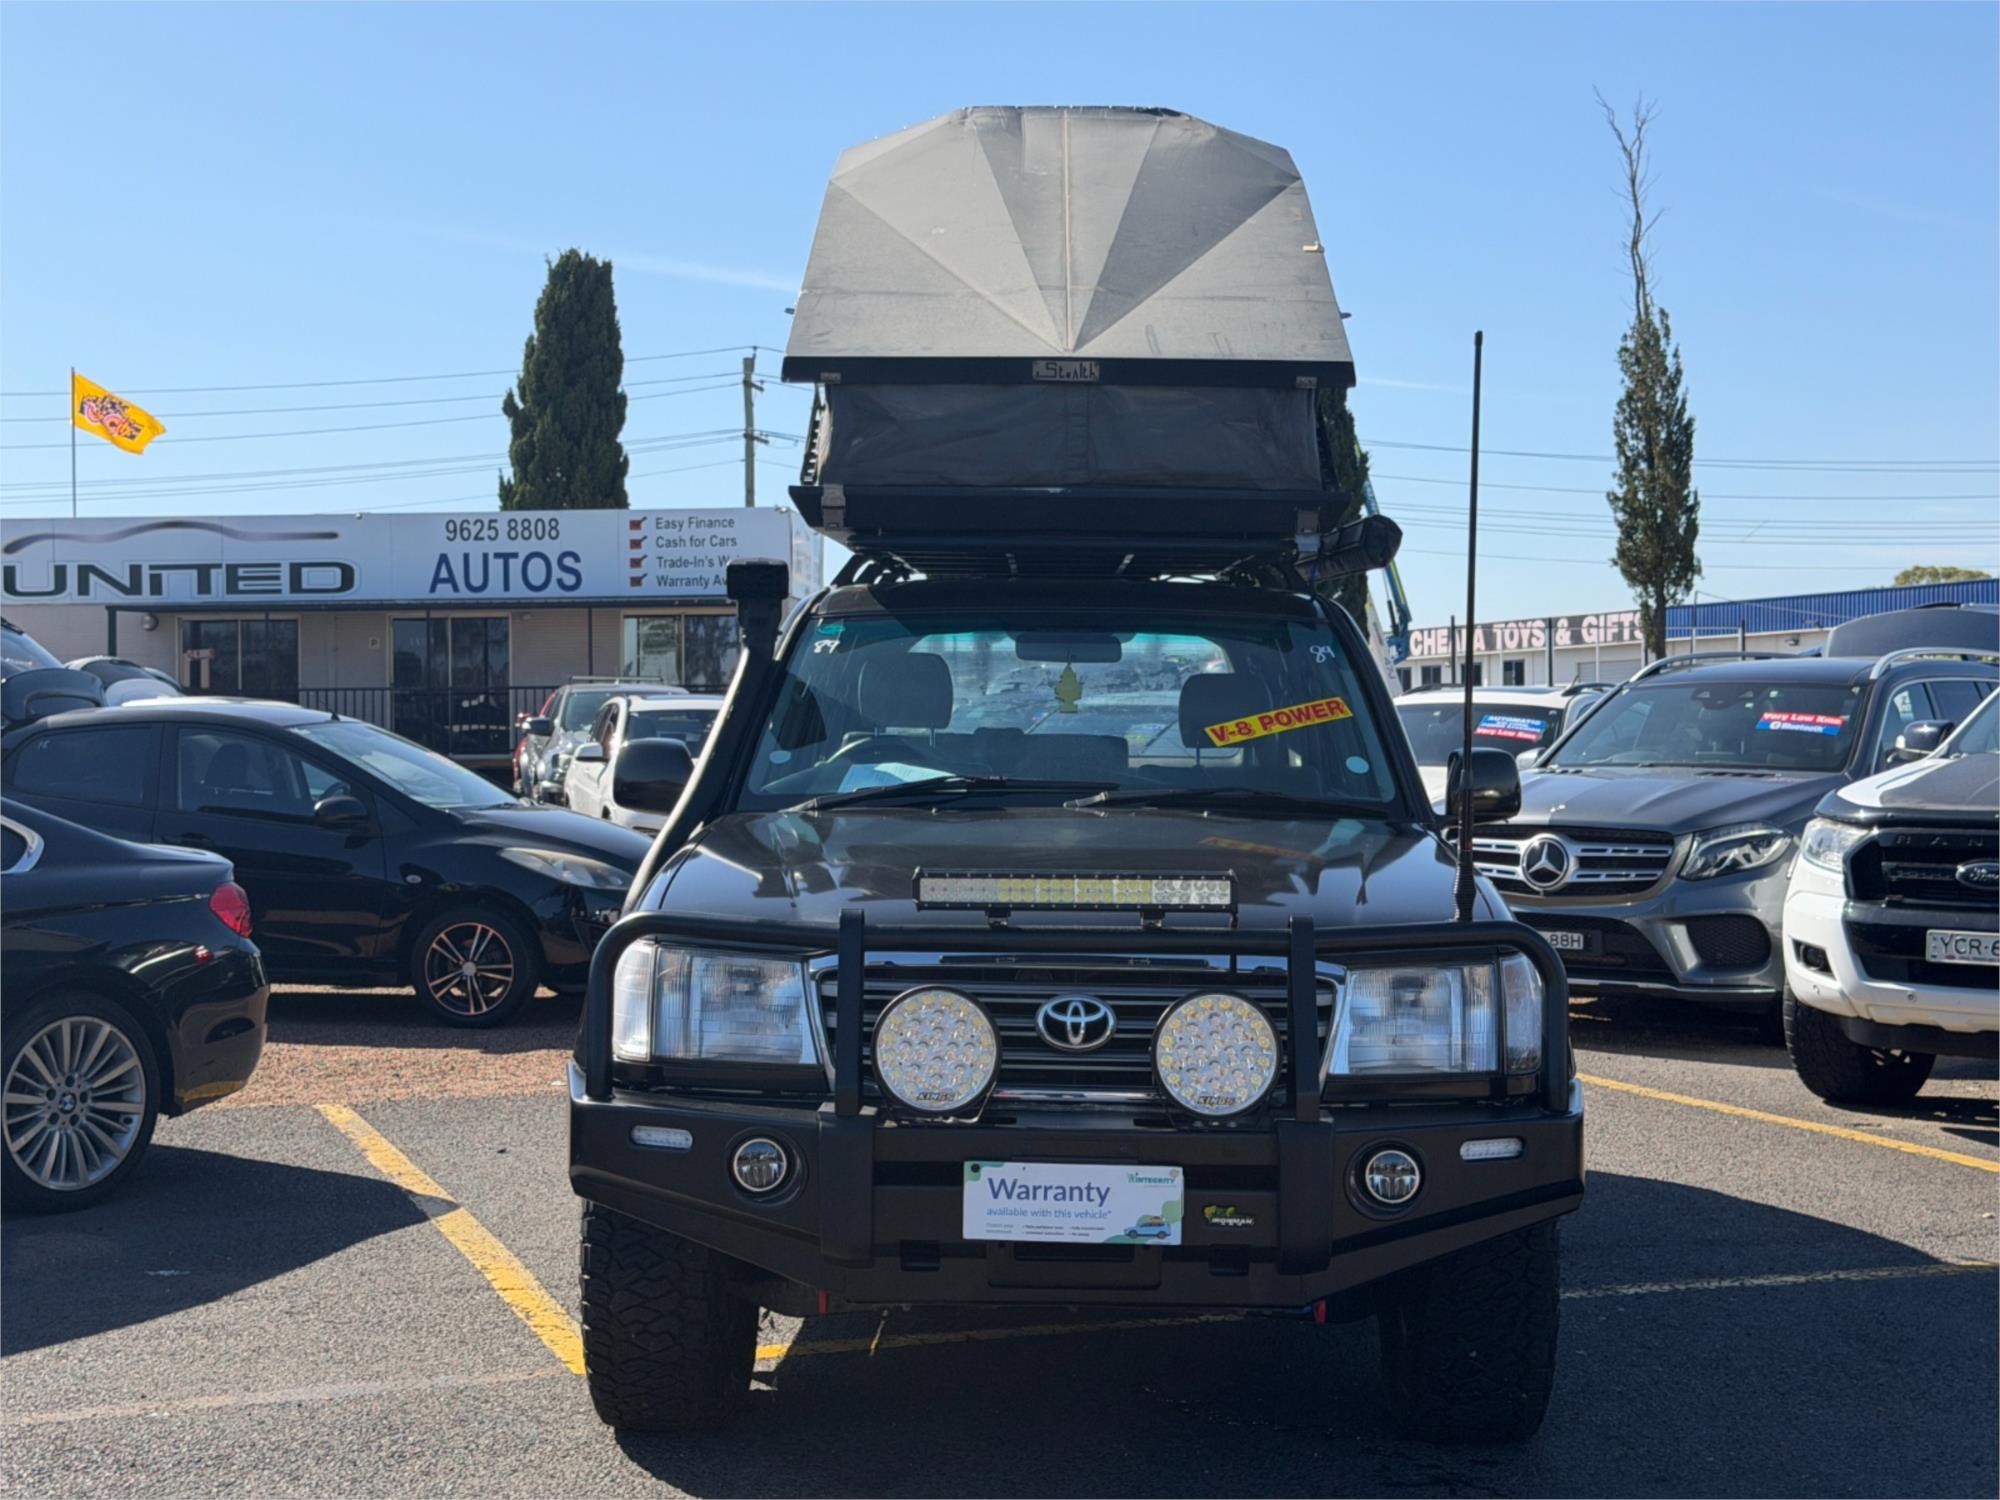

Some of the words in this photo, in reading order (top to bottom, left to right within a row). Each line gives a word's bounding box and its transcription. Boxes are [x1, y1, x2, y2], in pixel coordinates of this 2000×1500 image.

[445, 518, 499, 541] 9625
[507, 517, 560, 541] 8808
[655, 517, 684, 532] Easy
[688, 516, 735, 529] Finance
[656, 536, 686, 549] Cash
[690, 535, 706, 547] for
[710, 534, 737, 547] Cars
[429, 550, 583, 593] AUTOS
[657, 555, 715, 569] Trade-In's
[3, 562, 355, 597] UNITED
[656, 575, 710, 590] Warranty
[1493, 620, 1546, 650] TOYS
[1555, 618, 1572, 645] &
[1210, 720, 1254, 743] V-8
[1257, 699, 1347, 732] POWER
[987, 1177, 1111, 1208] Warranty
[986, 1207, 1028, 1217] available
[1030, 1208, 1052, 1217] with
[1054, 1209, 1072, 1218] this
